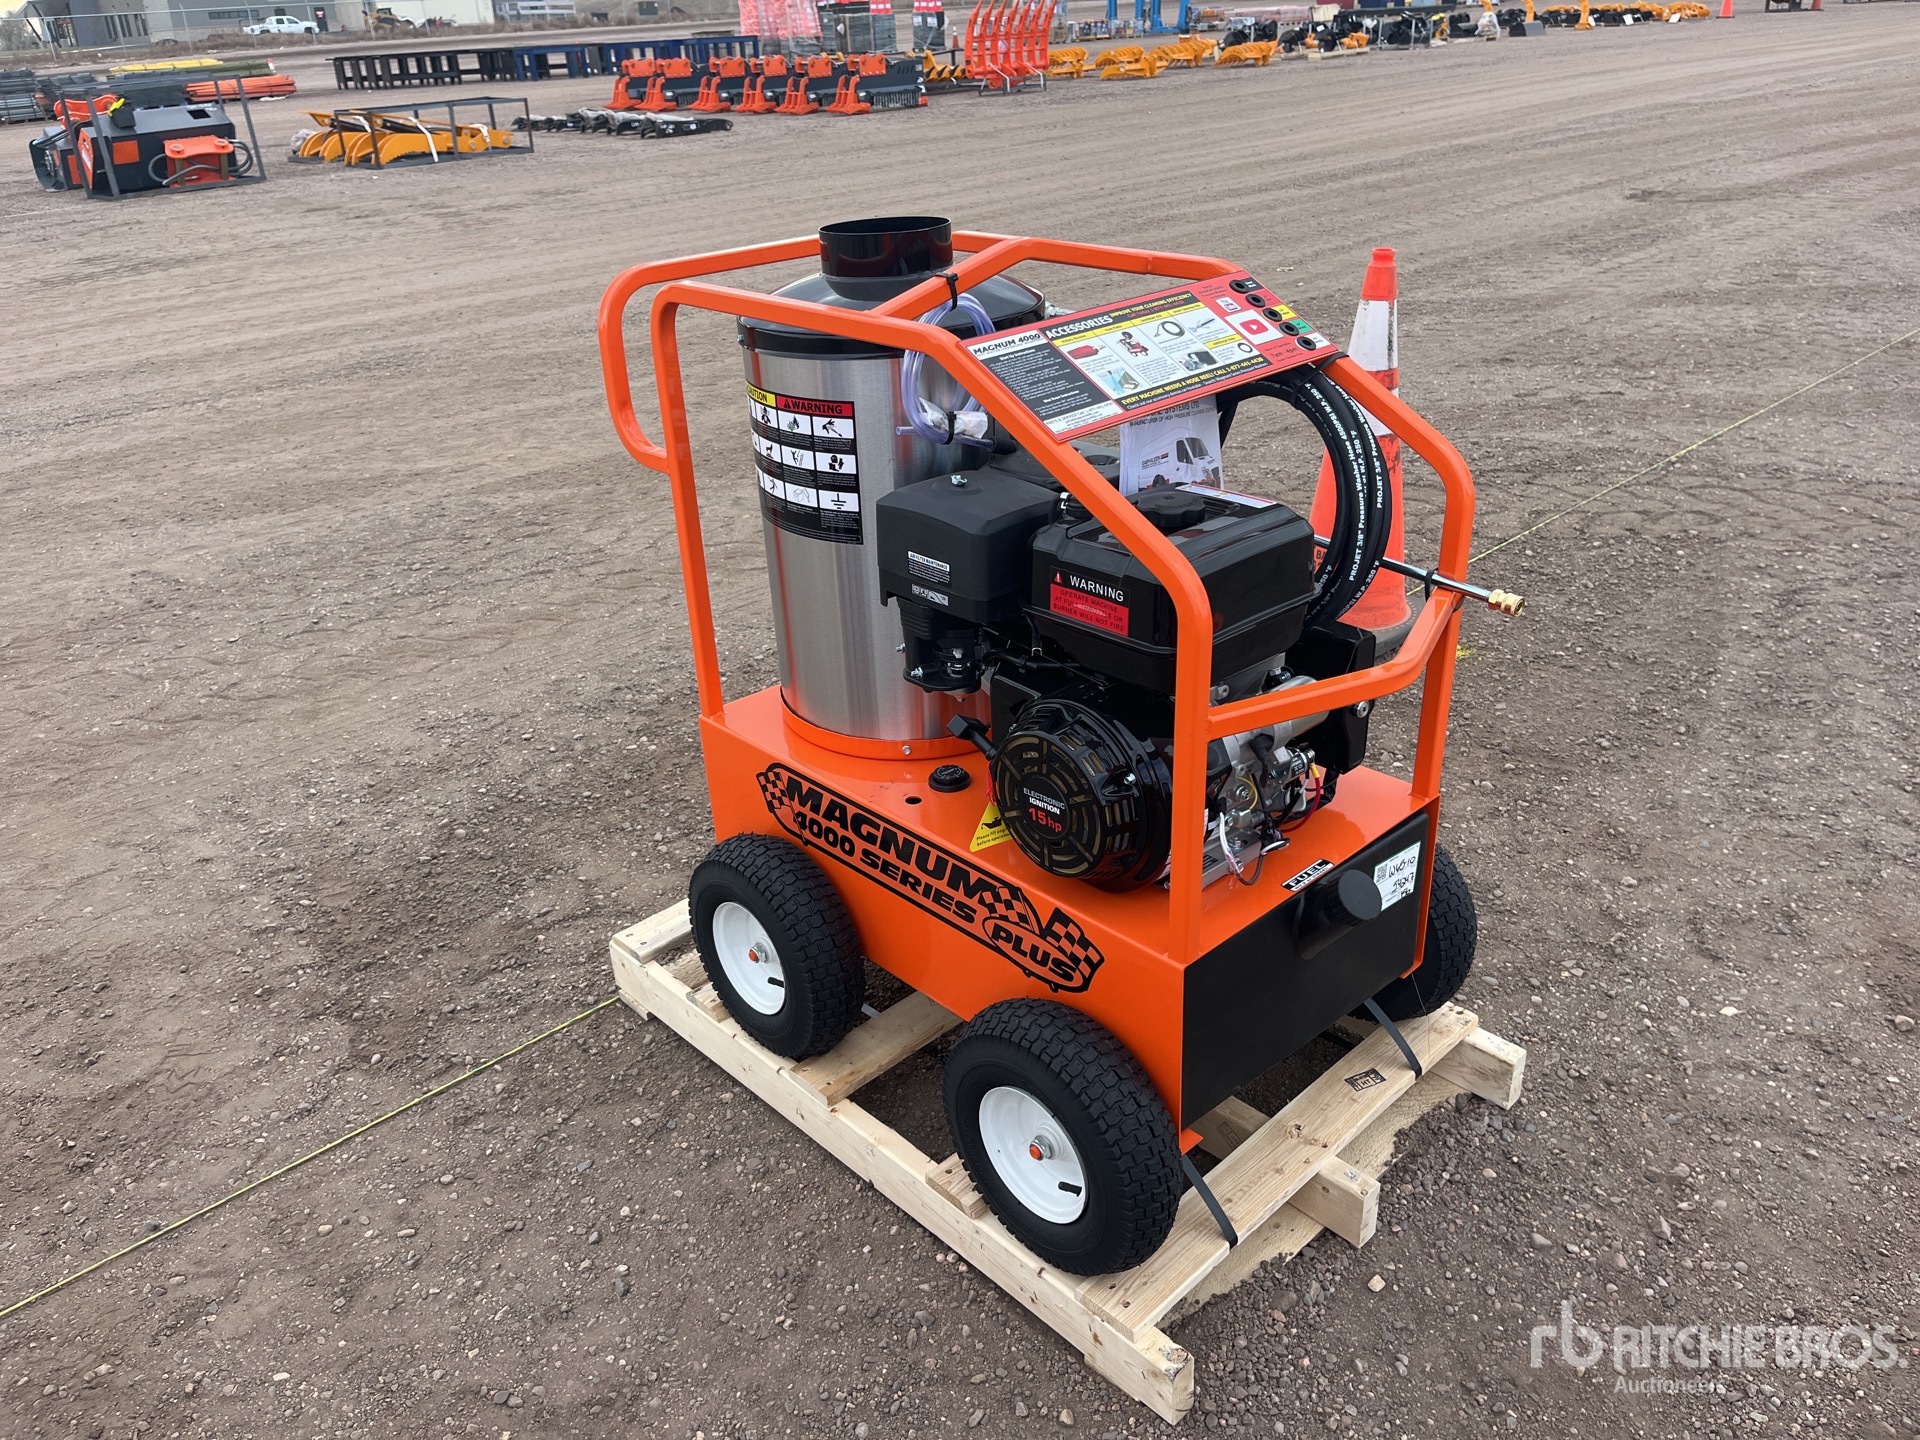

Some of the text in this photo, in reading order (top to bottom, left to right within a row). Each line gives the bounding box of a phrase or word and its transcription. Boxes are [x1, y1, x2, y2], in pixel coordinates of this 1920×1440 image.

[1109, 308, 1132, 317] IMPROVE
[1143, 299, 1167, 308] CLEANING
[1166, 292, 1193, 302] EFFICIENCY
[1042, 314, 1114, 338] ACCESSORIES
[972, 332, 1041, 354] MAGNUM 4000
[1121, 395, 1140, 405] EVERY
[1139, 387, 1165, 399] MACHINE
[1164, 382, 1182, 391] NEEDS
[1185, 376, 1201, 385] HOSE
[1214, 368, 1228, 376] CALL
[1311, 387, 1322, 400] 250
[791, 400, 842, 415] WARNING
[1174, 411, 1190, 420] PRESSURE
[1348, 398, 1365, 423] Washer
[1328, 411, 1347, 440] 4500PSI
[1344, 440, 1355, 459] Hose
[1353, 439, 1363, 455] 250
[1363, 424, 1377, 456] Pressure
[1352, 459, 1363, 491] Washer
[915, 555, 926, 563] FILTER
[926, 558, 948, 571] MAINTENANCE
[1349, 548, 1362, 581] PROJET
[1366, 569, 1376, 583] 250
[1070, 575, 1124, 602] WARNING
[1060, 590, 1089, 603] OPERATE
[1091, 598, 1118, 613] MACHINE
[1064, 598, 1078, 607] FULL
[1114, 615, 1123, 623] OR
[1054, 603, 1078, 616] BURNER
[1080, 611, 1094, 621] WILL
[1096, 617, 1108, 626] NOT
[1110, 621, 1124, 632] FIRE
[1023, 787, 1066, 811] ELECTRONIC
[1029, 796, 1061, 816] IGNITION
[784, 776, 994, 906] MAGNUM
[976, 833, 990, 841] Please
[976, 832, 1010, 847] before operatio
[793, 810, 977, 925] 4000 SERIES
[1288, 863, 1327, 887] FUEL
[990, 923, 1077, 983] PLUS
